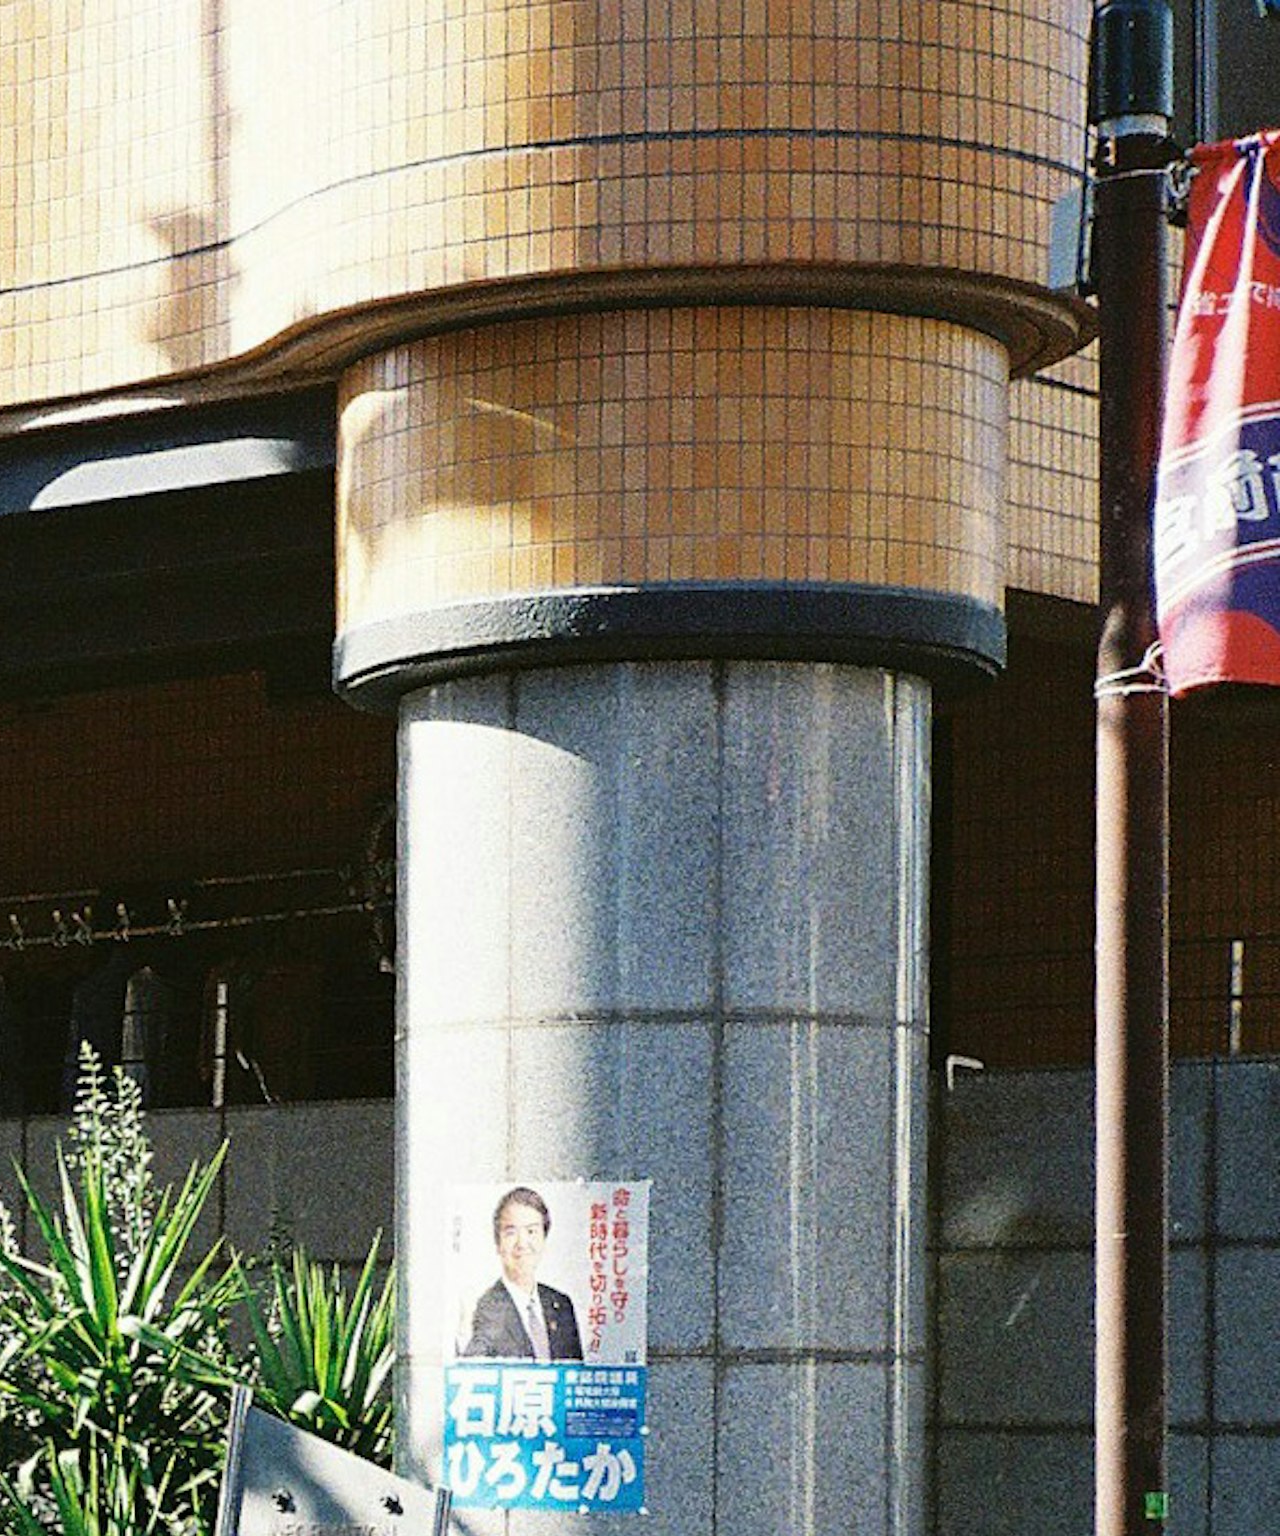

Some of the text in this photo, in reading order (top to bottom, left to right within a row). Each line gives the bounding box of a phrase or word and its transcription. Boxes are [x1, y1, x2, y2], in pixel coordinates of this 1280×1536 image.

[448, 1368, 558, 1438] 石原
[447, 1443, 637, 1502] ひろたか
